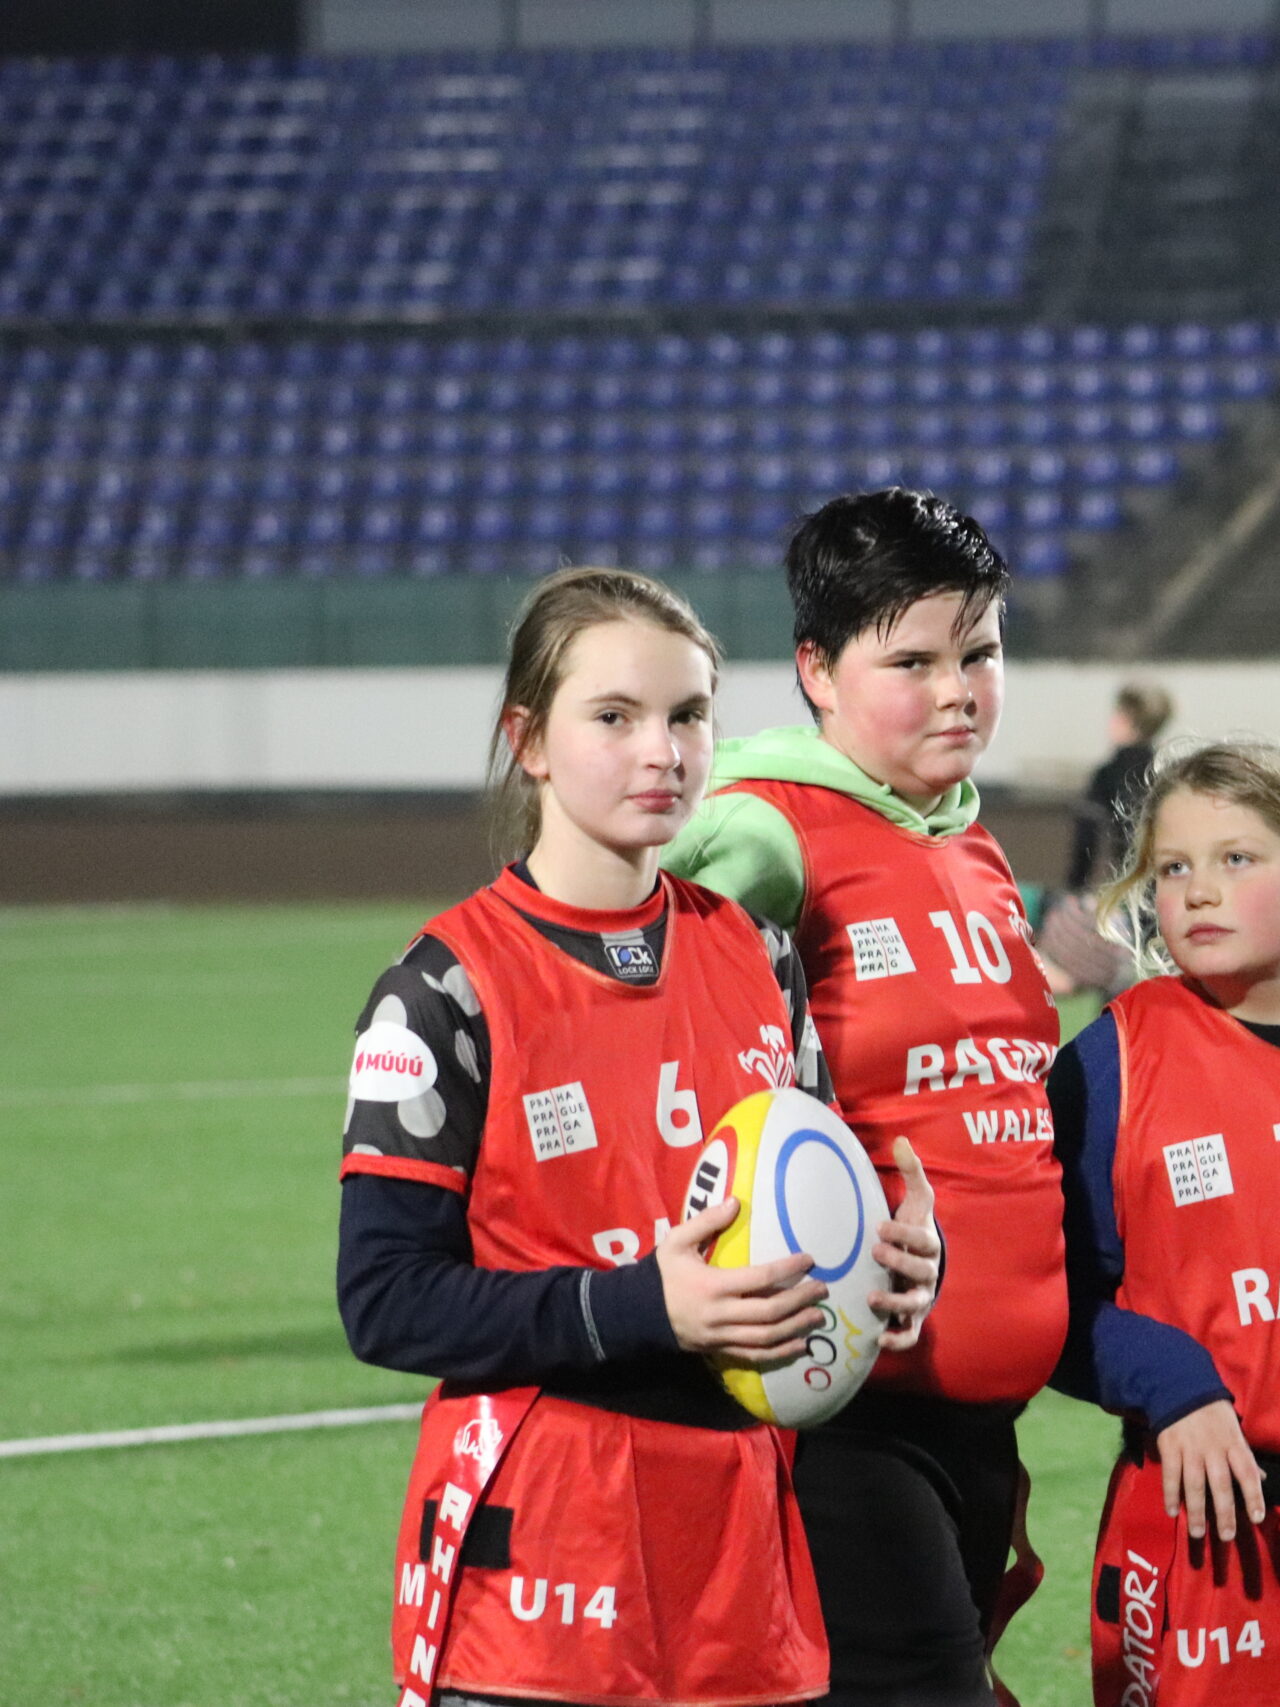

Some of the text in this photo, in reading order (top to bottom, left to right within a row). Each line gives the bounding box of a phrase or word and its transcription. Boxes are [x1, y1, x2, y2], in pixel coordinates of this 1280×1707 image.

[929, 910, 1012, 985] 10
[366, 1050, 423, 1077] MÚÚÚ
[655, 1060, 702, 1148] 6
[510, 1576, 618, 1628] U14
[1177, 1620, 1265, 1667] U14
